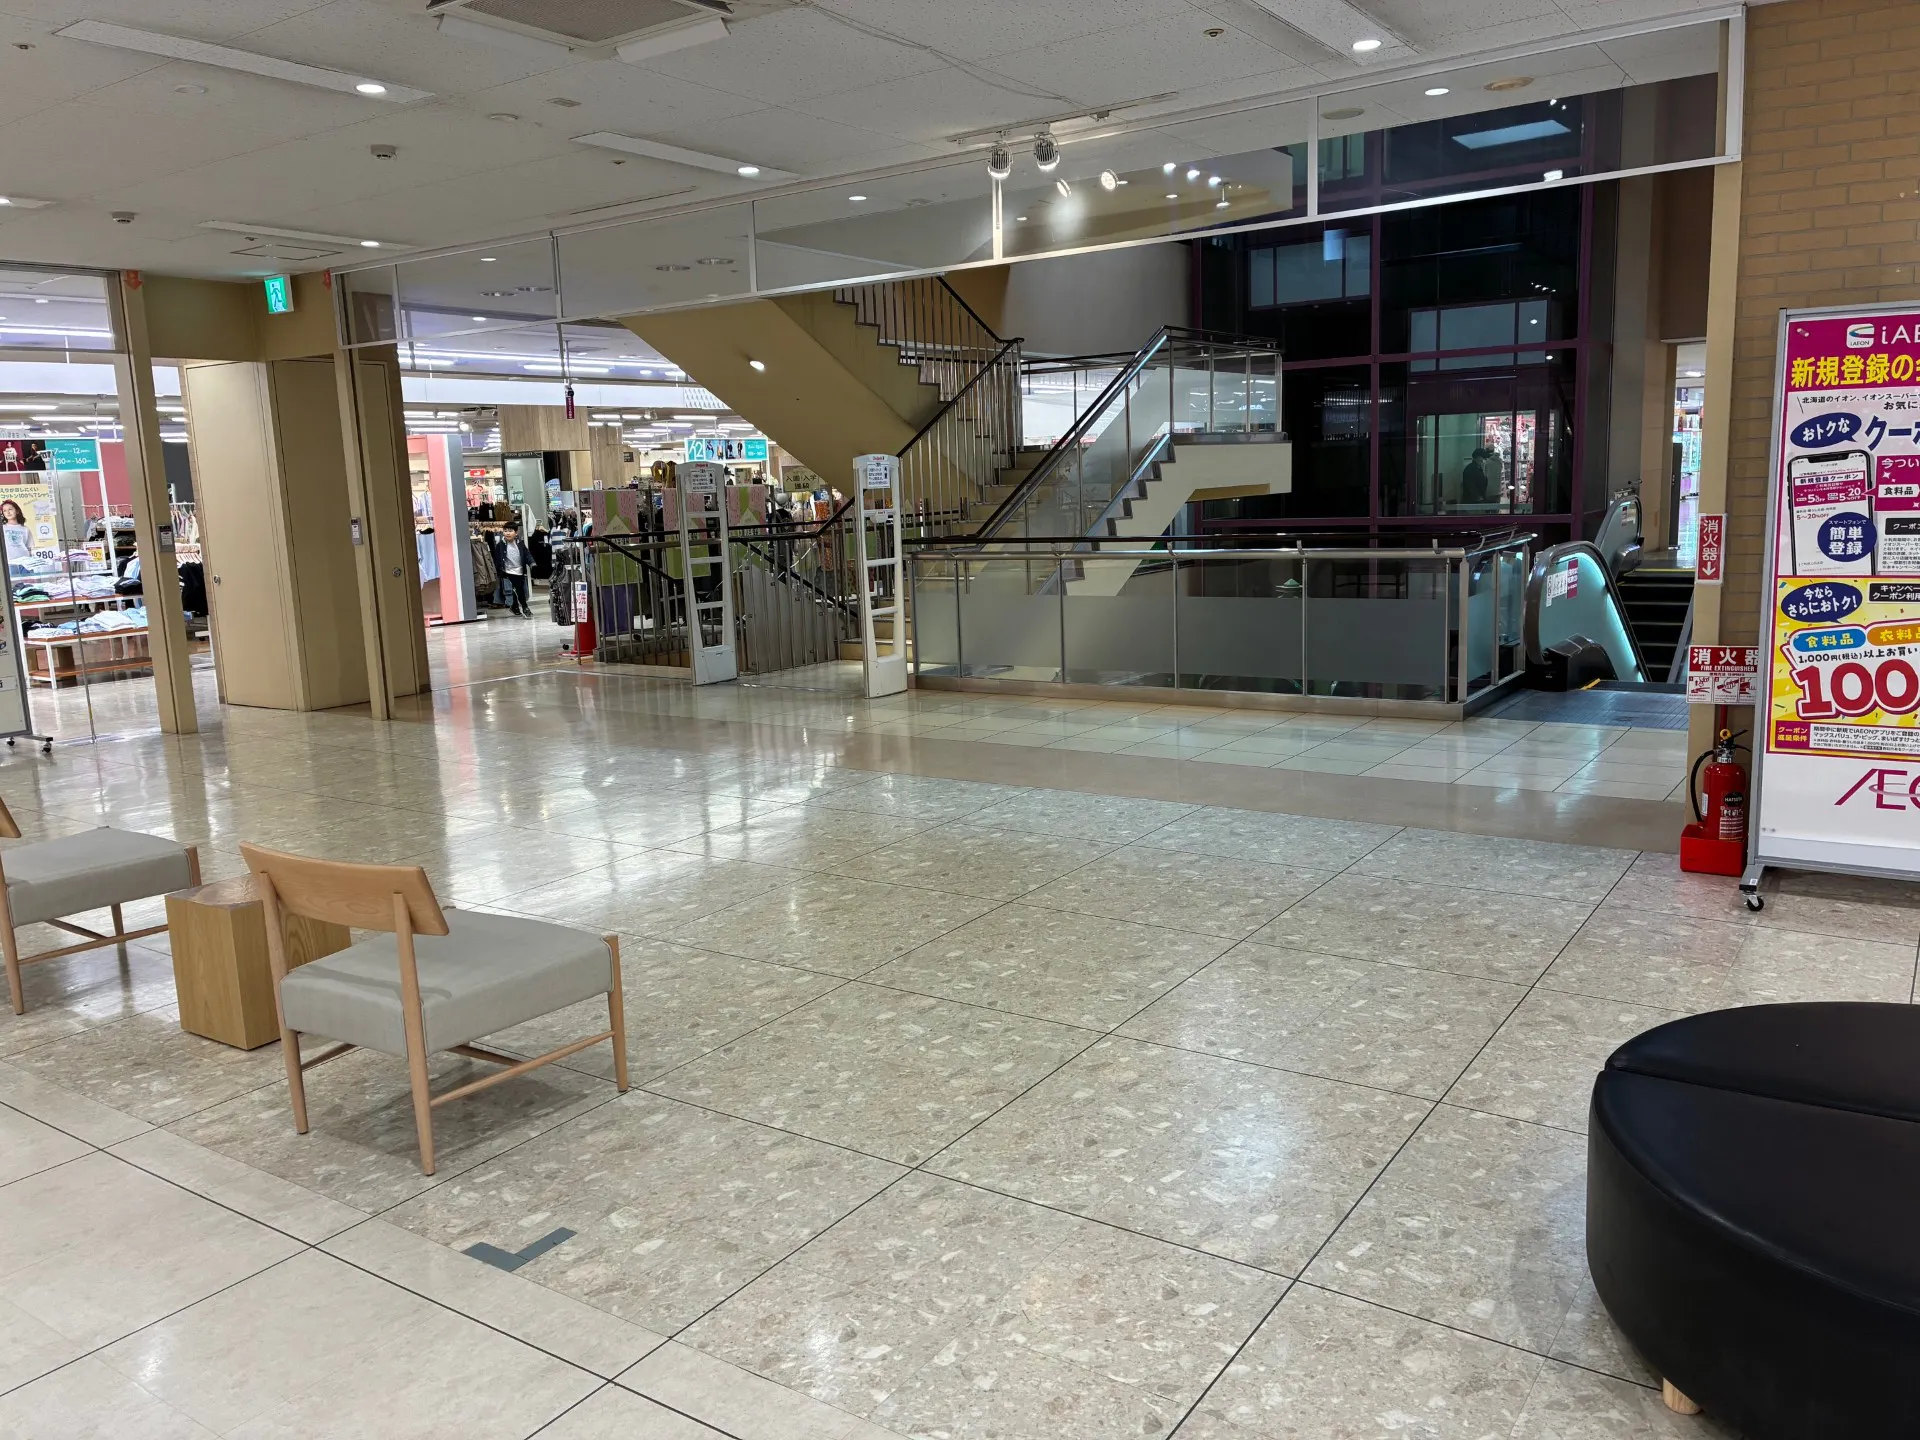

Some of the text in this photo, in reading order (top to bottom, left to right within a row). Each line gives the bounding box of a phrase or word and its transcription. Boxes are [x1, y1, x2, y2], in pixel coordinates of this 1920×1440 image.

[1791, 354, 1920, 388] 新規登録の
[1802, 393, 1920, 404] 北海道のイオン、イオンスーパー
[1883, 401, 1920, 410] お気に
[1802, 417, 1850, 442] おトクな
[1884, 487, 1914, 496] 食料品
[1702, 519, 1719, 561] 消火器
[1829, 526, 1864, 541] 簡単
[36, 551, 54, 559] 980
[1828, 541, 1863, 555] 登録
[1803, 586, 1833, 600] 今なら
[1805, 632, 1854, 649] 食料品
[1692, 648, 1758, 665] 消火器
[1798, 646, 1920, 664] 1,000円(税込)以上お買い
[1778, 727, 1808, 735] クーポン
[1834, 768, 1920, 810] AE
